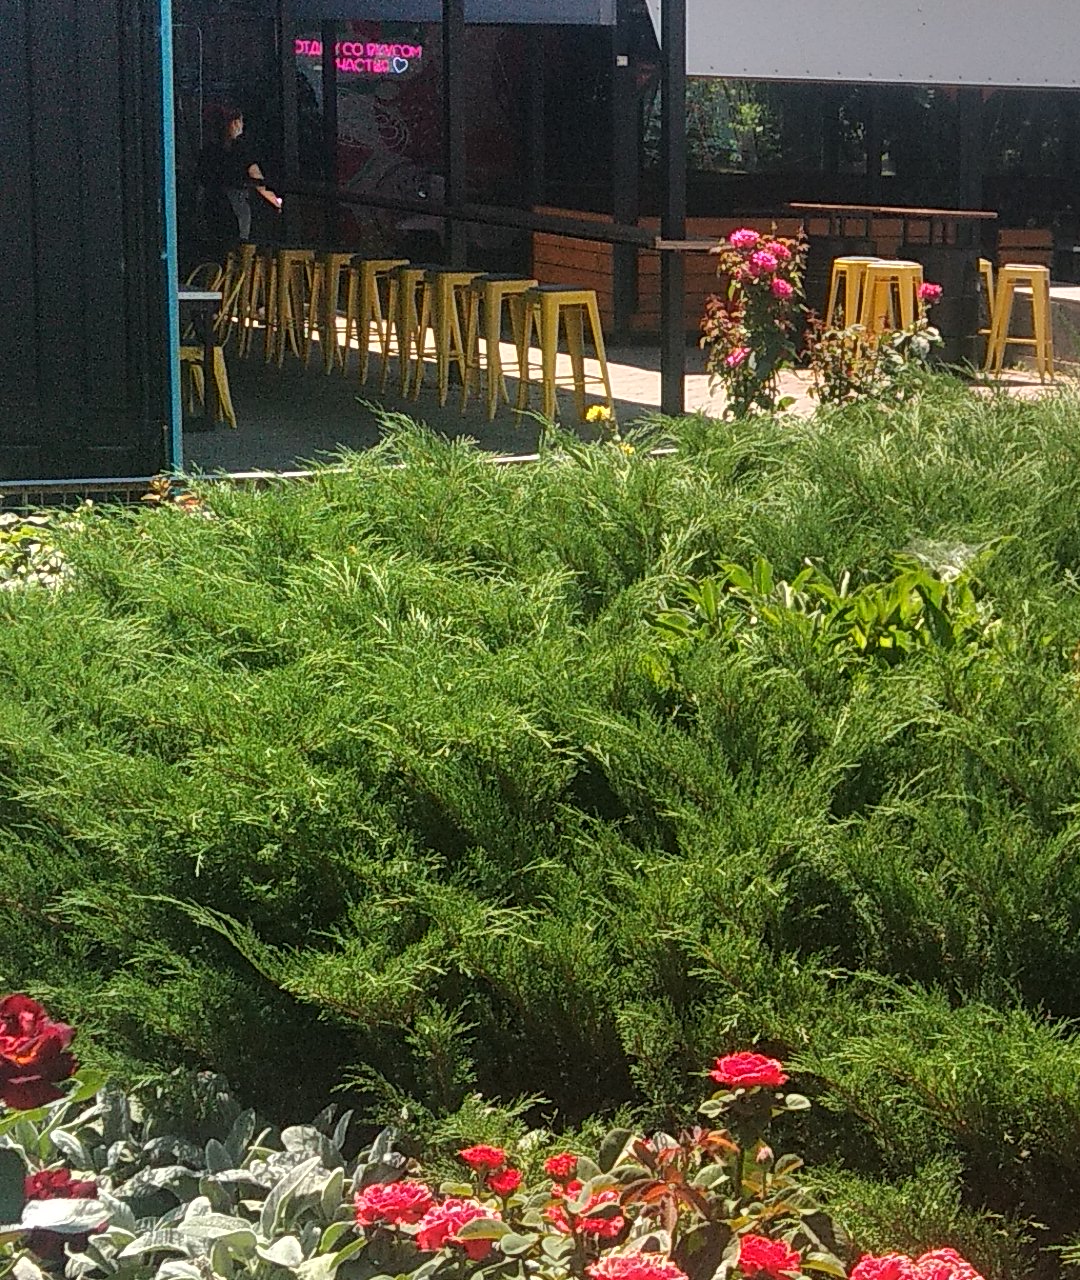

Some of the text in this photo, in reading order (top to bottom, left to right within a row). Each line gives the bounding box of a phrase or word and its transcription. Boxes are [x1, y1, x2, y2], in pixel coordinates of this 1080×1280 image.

[295, 39, 340, 56] ОТД
[342, 42, 364, 57] СО
[335, 58, 389, 73] ЧАСТЬЯ
